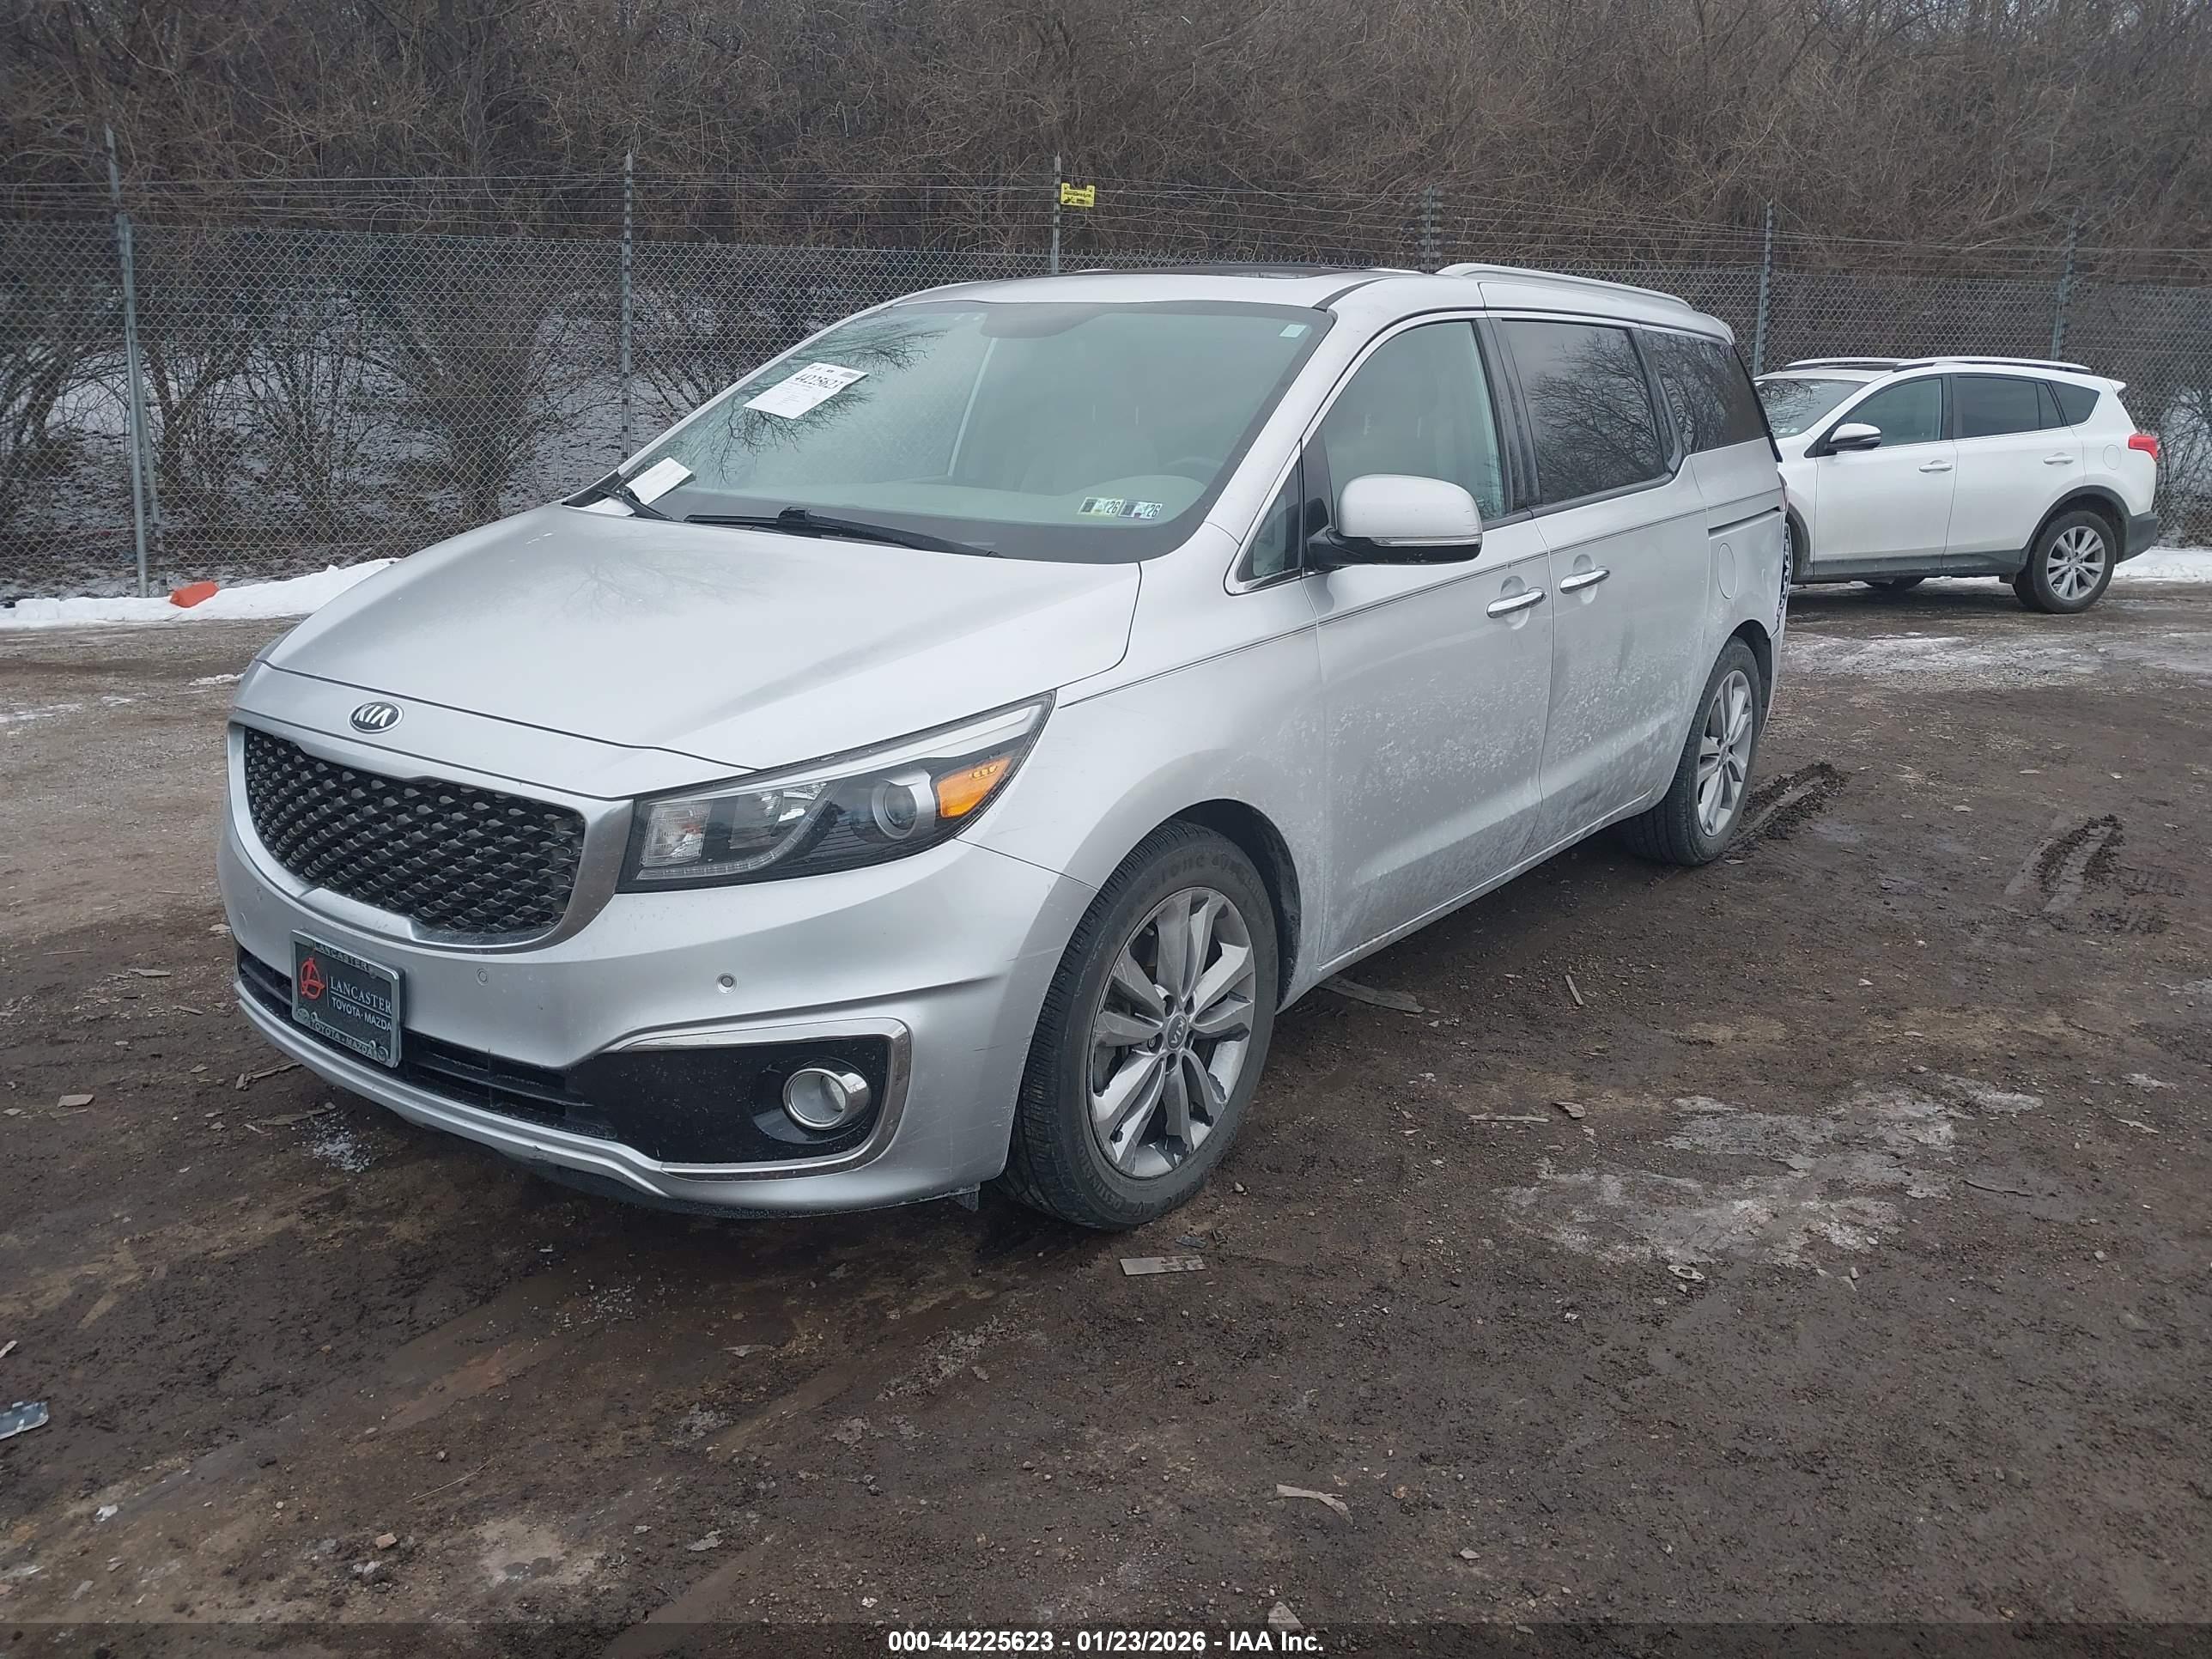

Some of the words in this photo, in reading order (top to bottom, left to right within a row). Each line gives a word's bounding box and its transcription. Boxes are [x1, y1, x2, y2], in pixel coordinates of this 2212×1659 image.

[353, 704, 392, 727] KIA
[313, 942, 369, 971] LANCASTER
[331, 976, 392, 1014] LANCASTER
[311, 1019, 340, 1041] TOYOTA
[345, 1037, 373, 1057] MAZDA
